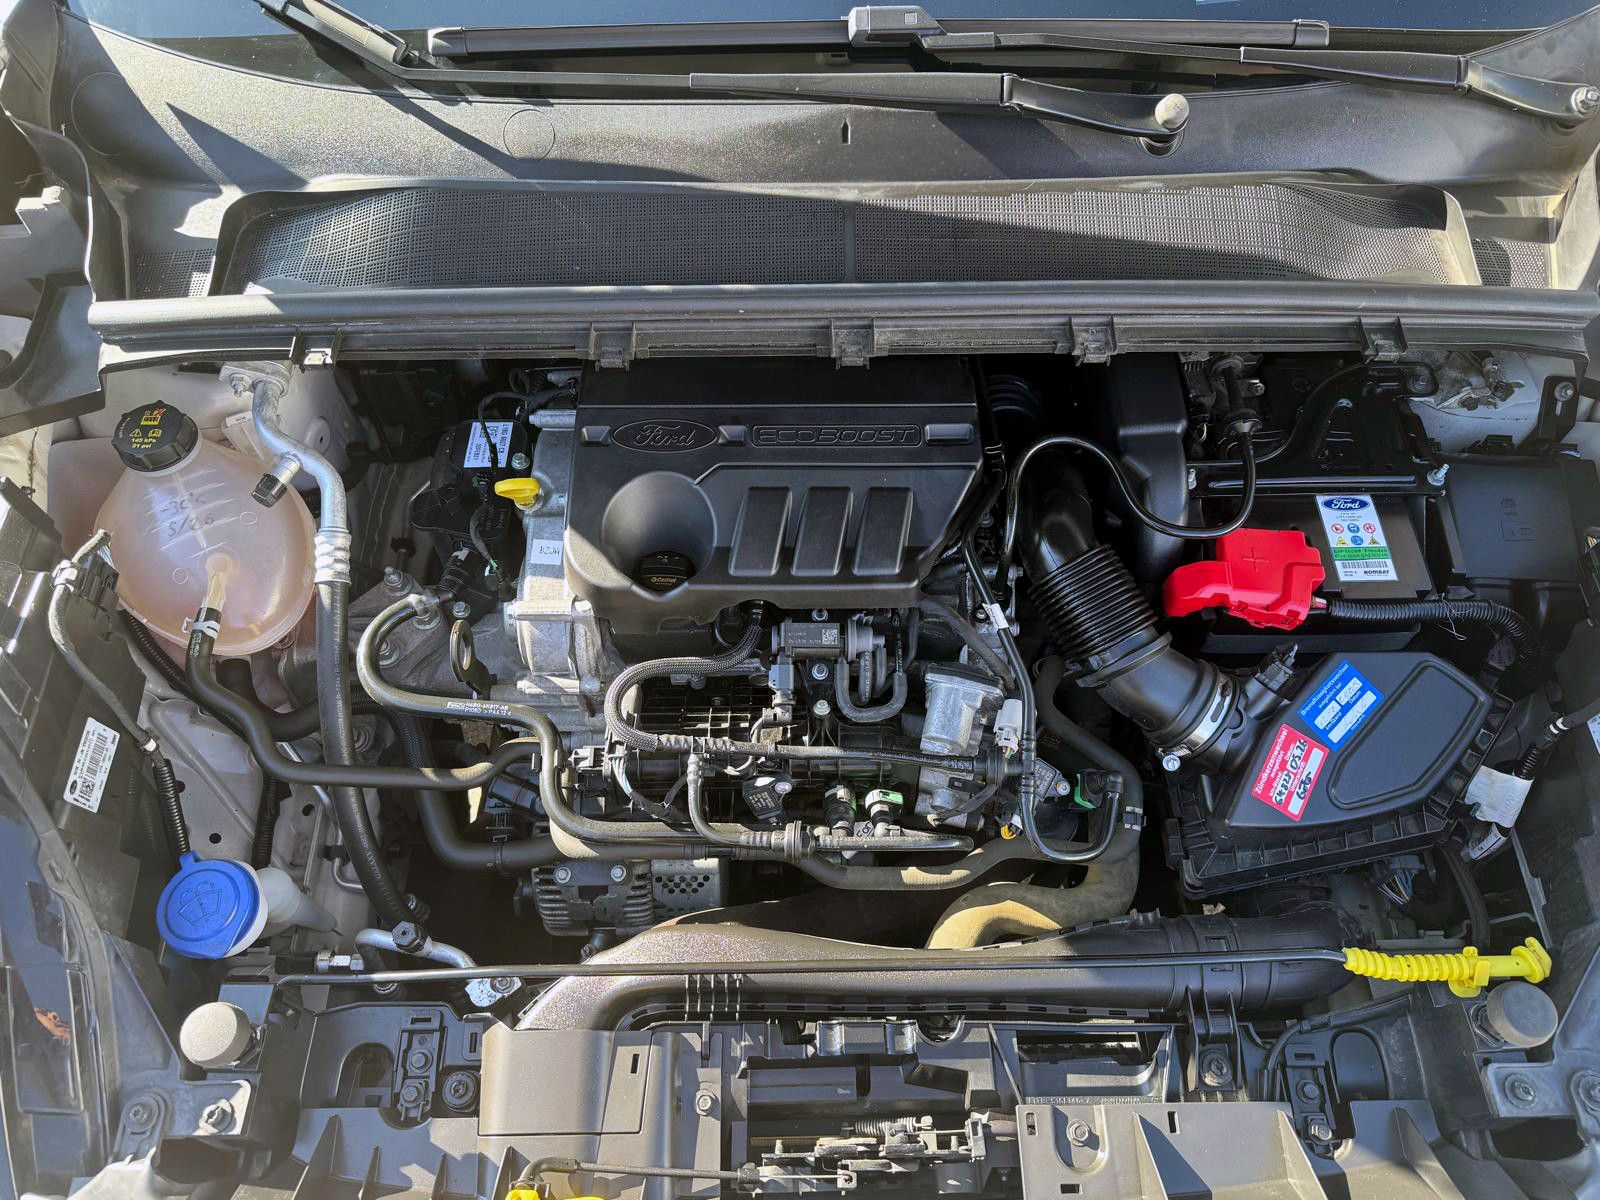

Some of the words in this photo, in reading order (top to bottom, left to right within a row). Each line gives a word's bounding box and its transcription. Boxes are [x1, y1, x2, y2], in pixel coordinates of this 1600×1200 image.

[633, 423, 697, 447] Ford
[757, 427, 916, 445] ECOBOOST
[1331, 499, 1361, 509] Ford
[1255, 728, 1289, 794] Zündkerzenwechsel
